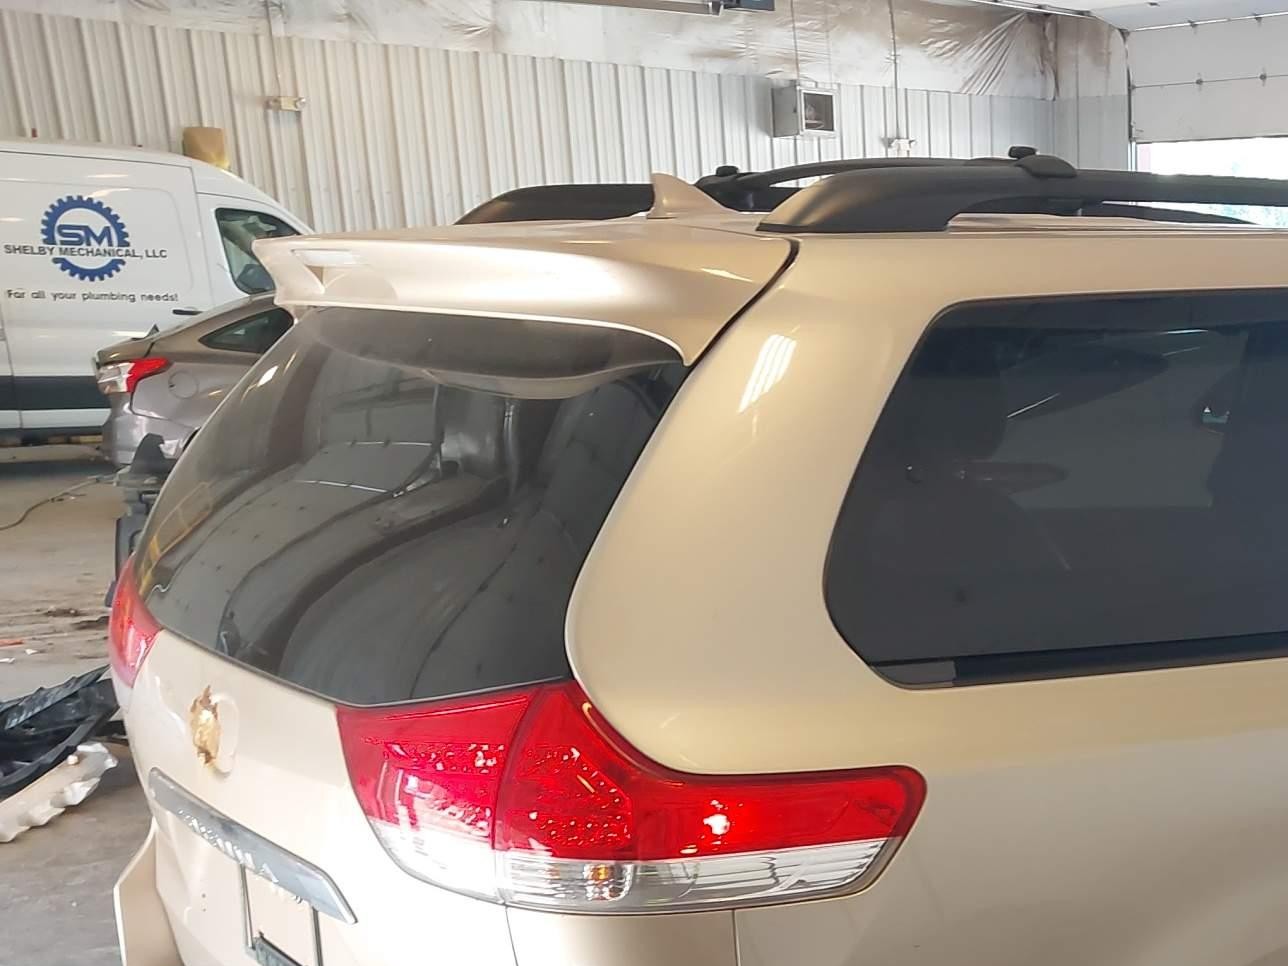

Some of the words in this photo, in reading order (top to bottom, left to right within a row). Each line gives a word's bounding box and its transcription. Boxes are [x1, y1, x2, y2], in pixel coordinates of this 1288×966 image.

[57, 224, 113, 247] SM
[4, 244, 54, 256] SHELBY
[59, 247, 144, 259] MECHANICAL,
[146, 250, 168, 258] LLC
[7, 289, 25, 299] For
[31, 290, 46, 299] all
[51, 291, 77, 301] your
[82, 291, 136, 303] plumbing
[140, 293, 179, 301] needs!
